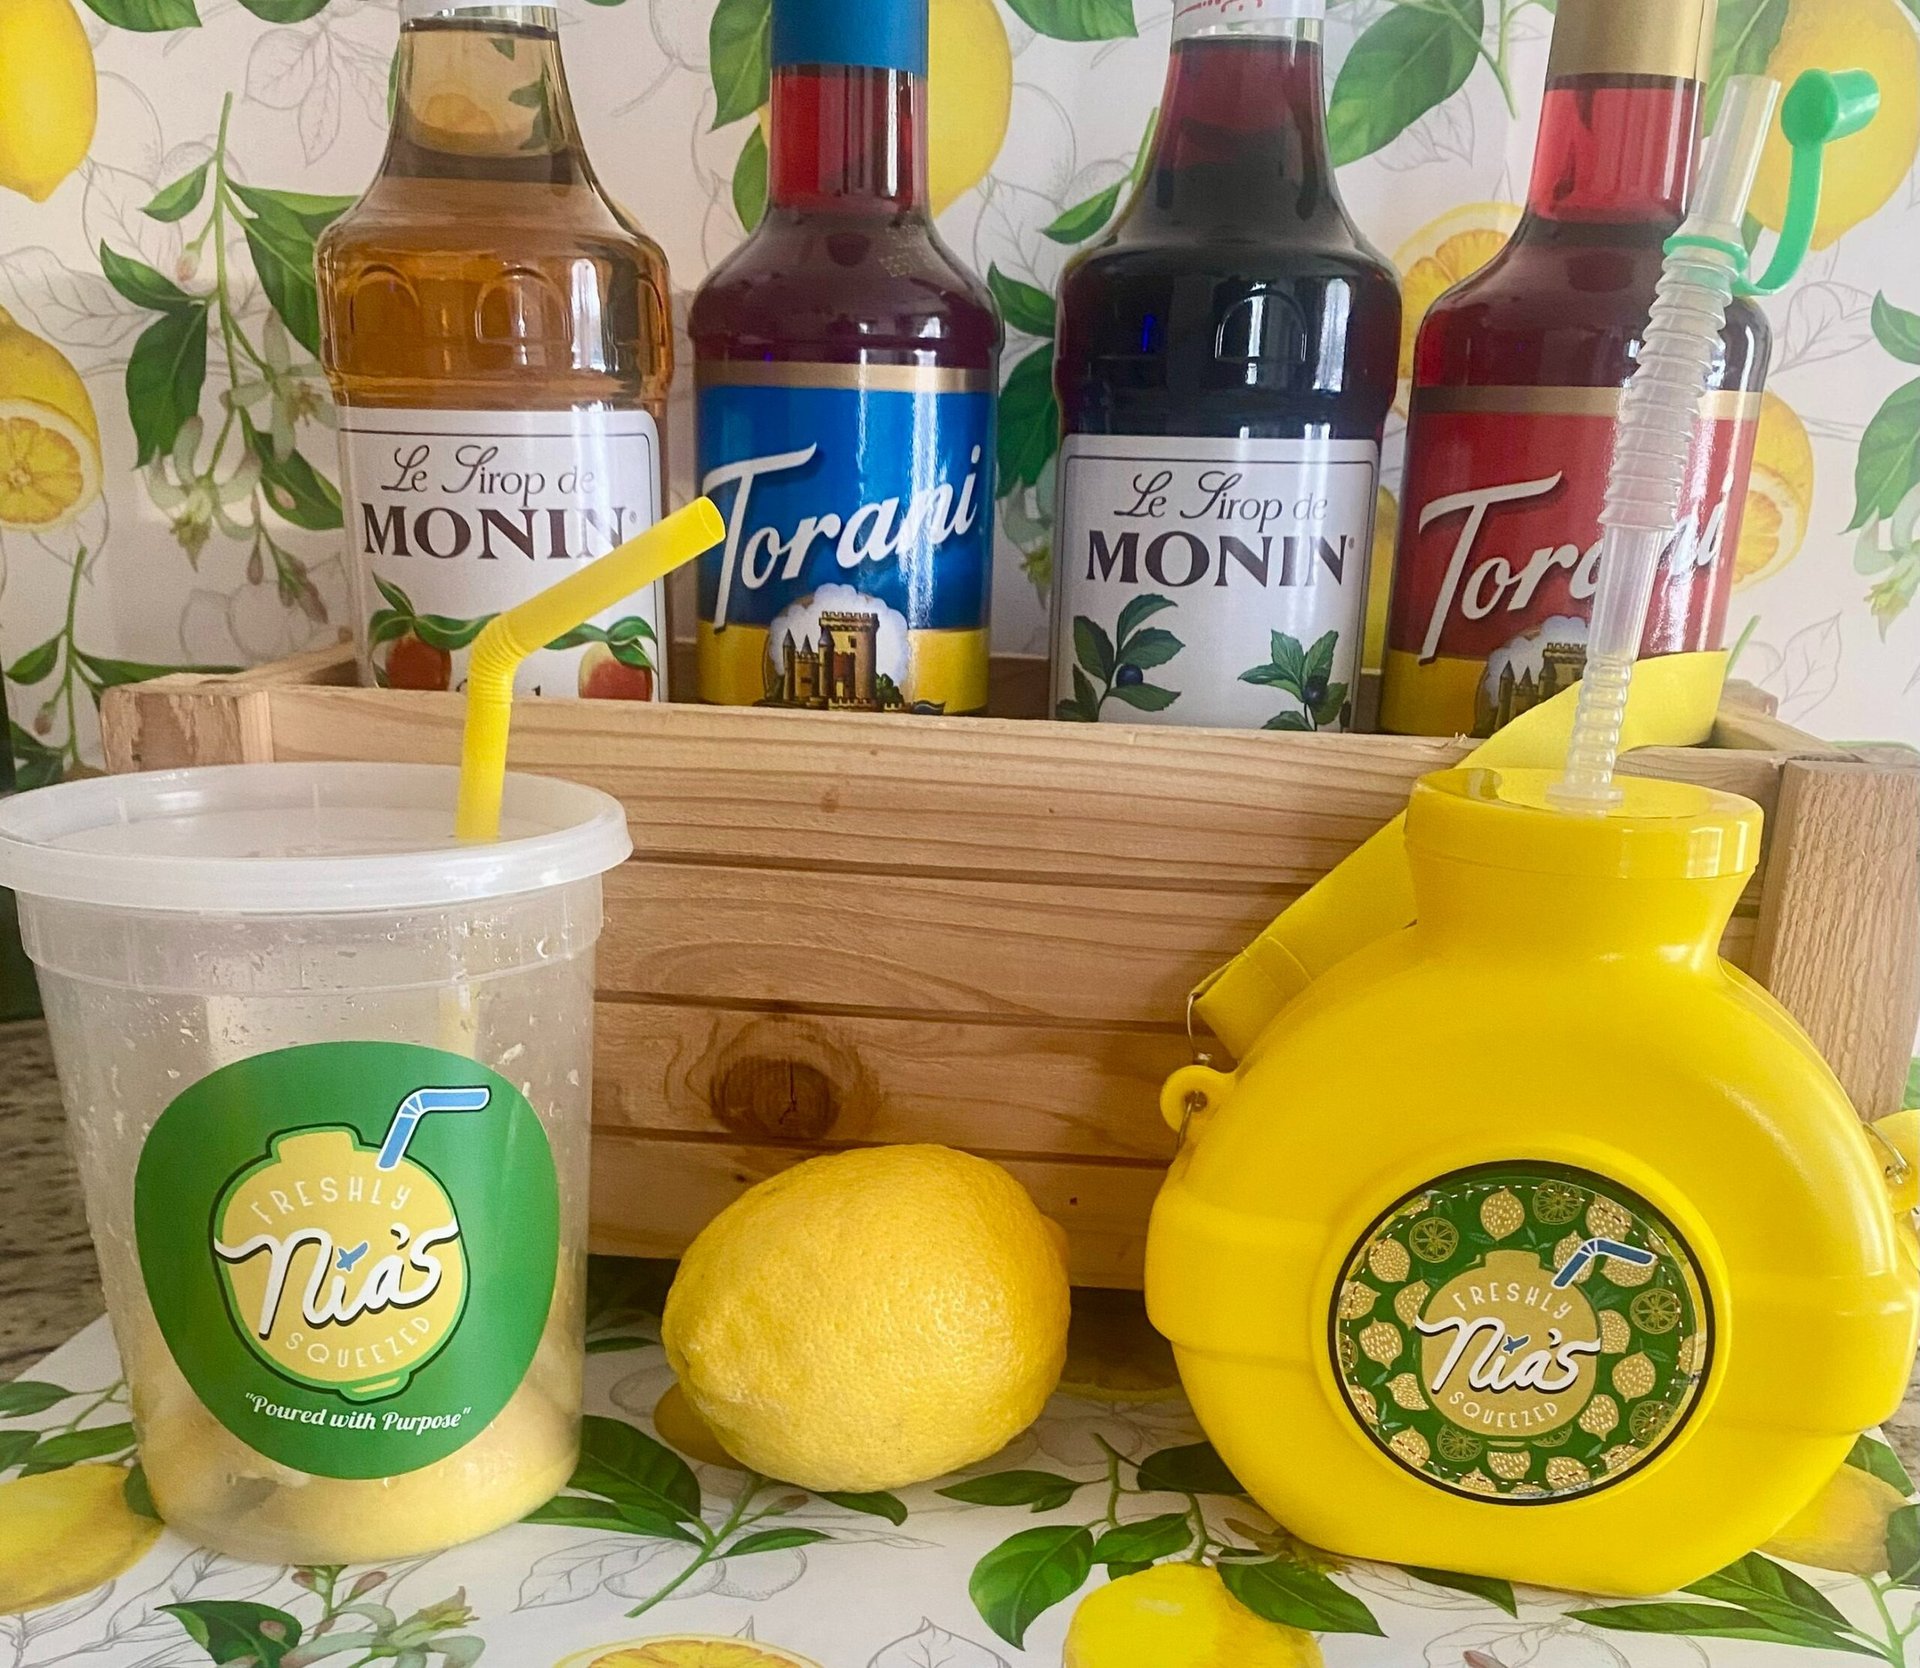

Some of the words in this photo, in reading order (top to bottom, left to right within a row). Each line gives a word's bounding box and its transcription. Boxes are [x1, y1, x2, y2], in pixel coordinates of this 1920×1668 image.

[381, 444, 430, 493] Le
[441, 444, 546, 507] Sirop
[557, 465, 596, 495] de
[1113, 470, 1173, 518] Le
[1179, 470, 1283, 533] Sirop
[1292, 493, 1328, 521] de
[361, 502, 626, 561] MONIN
[701, 441, 982, 634] Torani
[1085, 529, 1348, 588] MONIN
[249, 1175, 412, 1225] FRESHLY
[1452, 1281, 1573, 1320] FRESHLY
[285, 1315, 431, 1369] SQUEEZED
[329, 1410, 376, 1430] with
[1448, 1390, 1559, 1429] SQUEEZED
